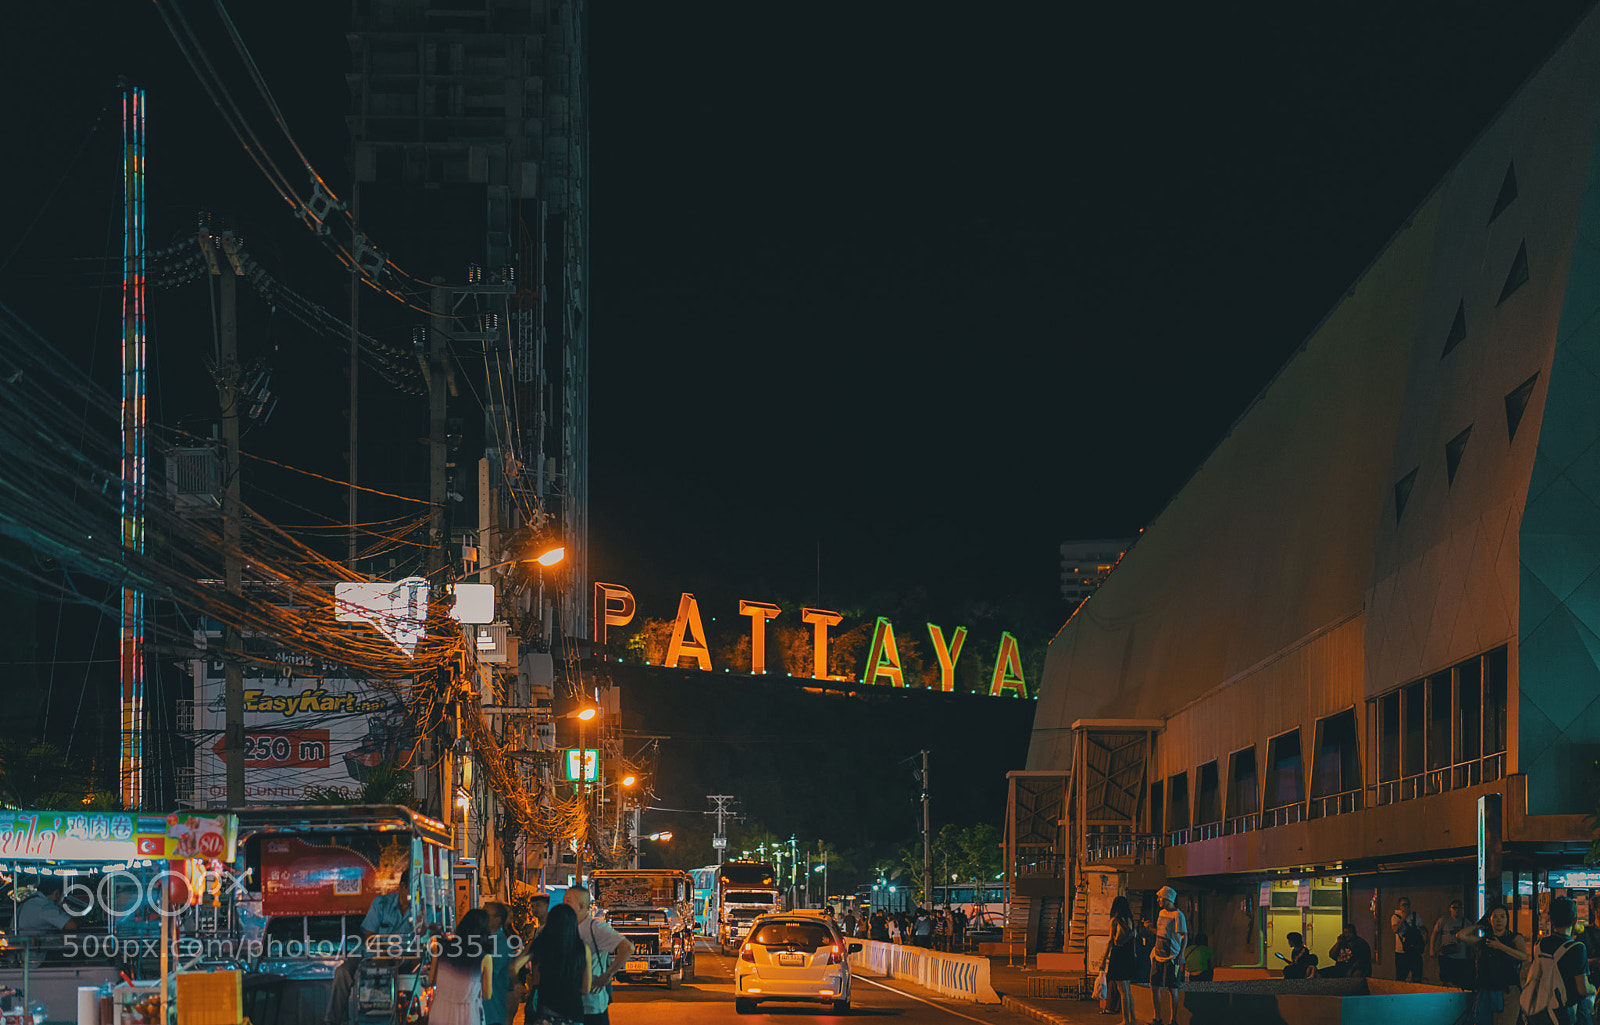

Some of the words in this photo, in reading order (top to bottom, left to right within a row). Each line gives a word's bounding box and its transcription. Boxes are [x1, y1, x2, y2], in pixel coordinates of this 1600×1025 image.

[594, 581, 1029, 699] PATTAYA
[244, 736, 291, 761] 250
[298, 741, 326, 761] m
[256, 785, 299, 797] UNTIL
[65, 815, 133, 840] 鸡肉卷
[199, 835, 223, 852] 80
